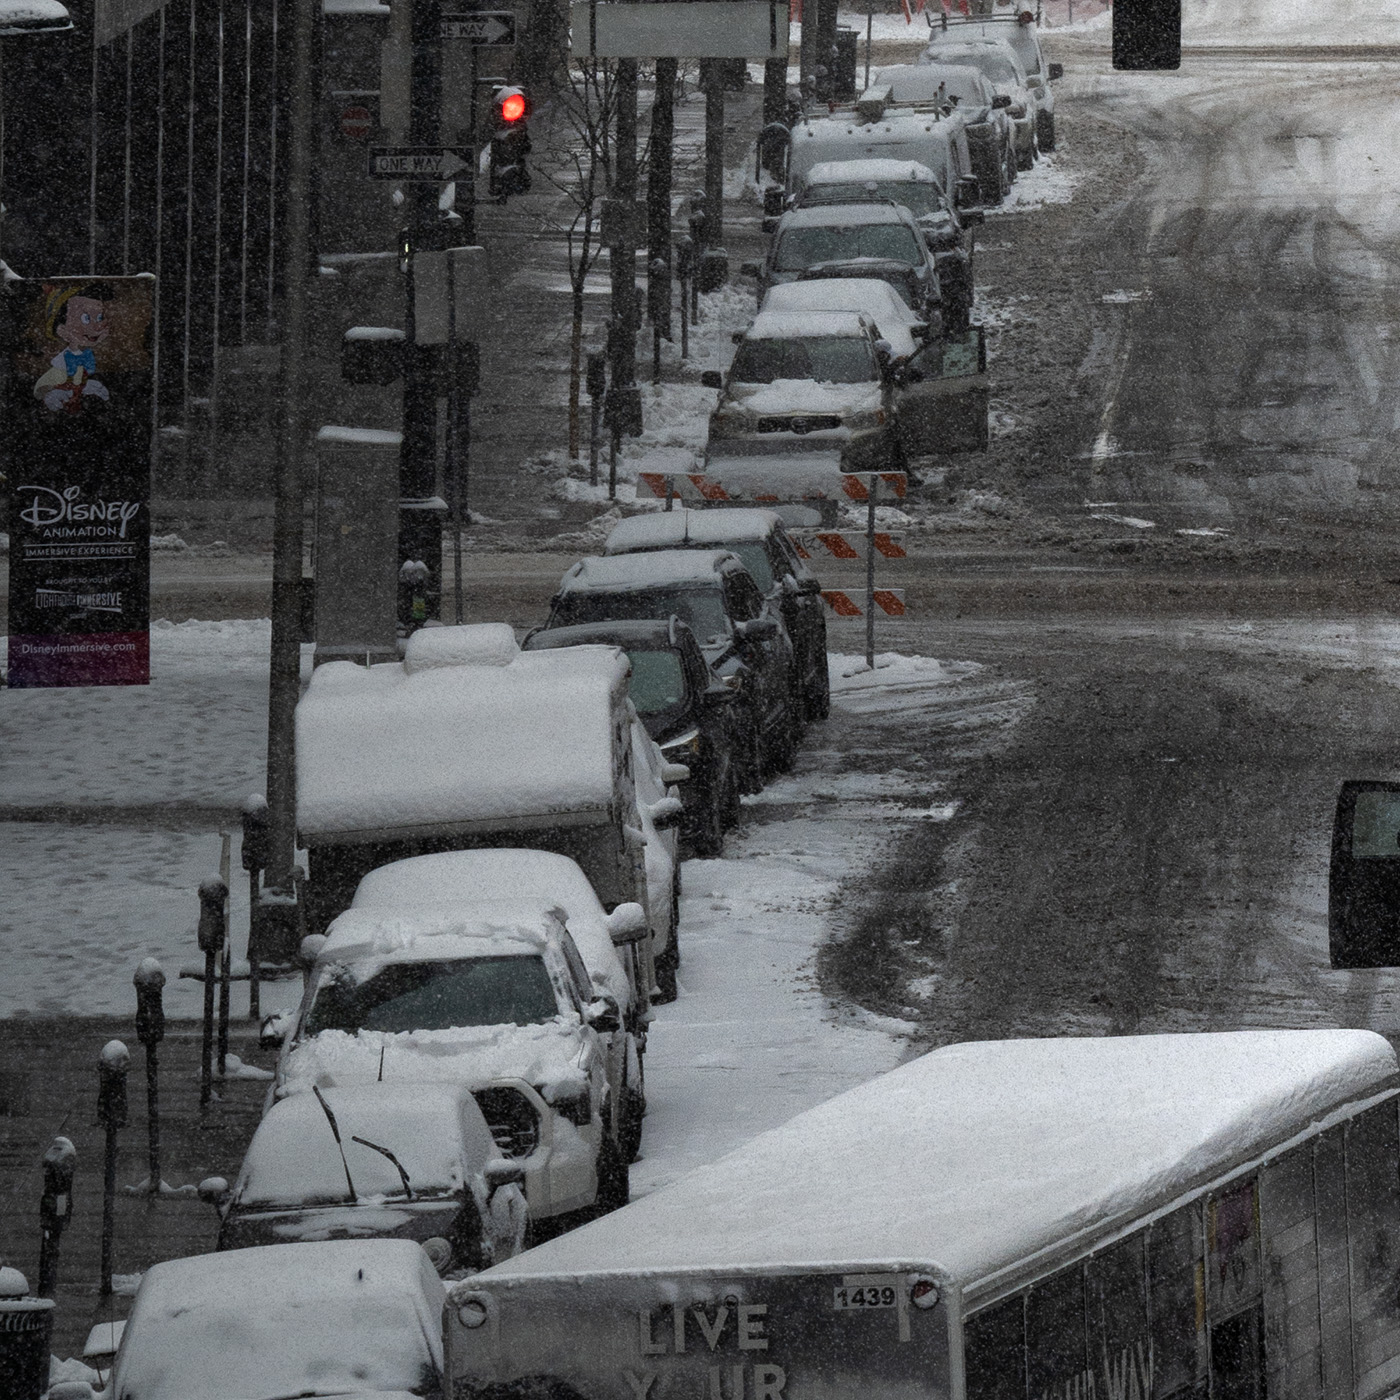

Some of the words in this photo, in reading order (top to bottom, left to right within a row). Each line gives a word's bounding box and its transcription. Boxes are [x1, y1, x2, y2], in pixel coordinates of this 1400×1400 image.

[459, 22, 486, 36] WAY
[380, 157, 407, 171] ONE
[411, 157, 442, 172] WAY
[43, 526, 117, 538] ANIMATION
[25, 547, 76, 557] IMMERSIVE
[78, 545, 134, 555] EXPERIENCE
[22, 643, 135, 656] DisneyImmersive.com
[837, 1287, 895, 1307] 1439
[640, 1303, 769, 1355] LIVE
